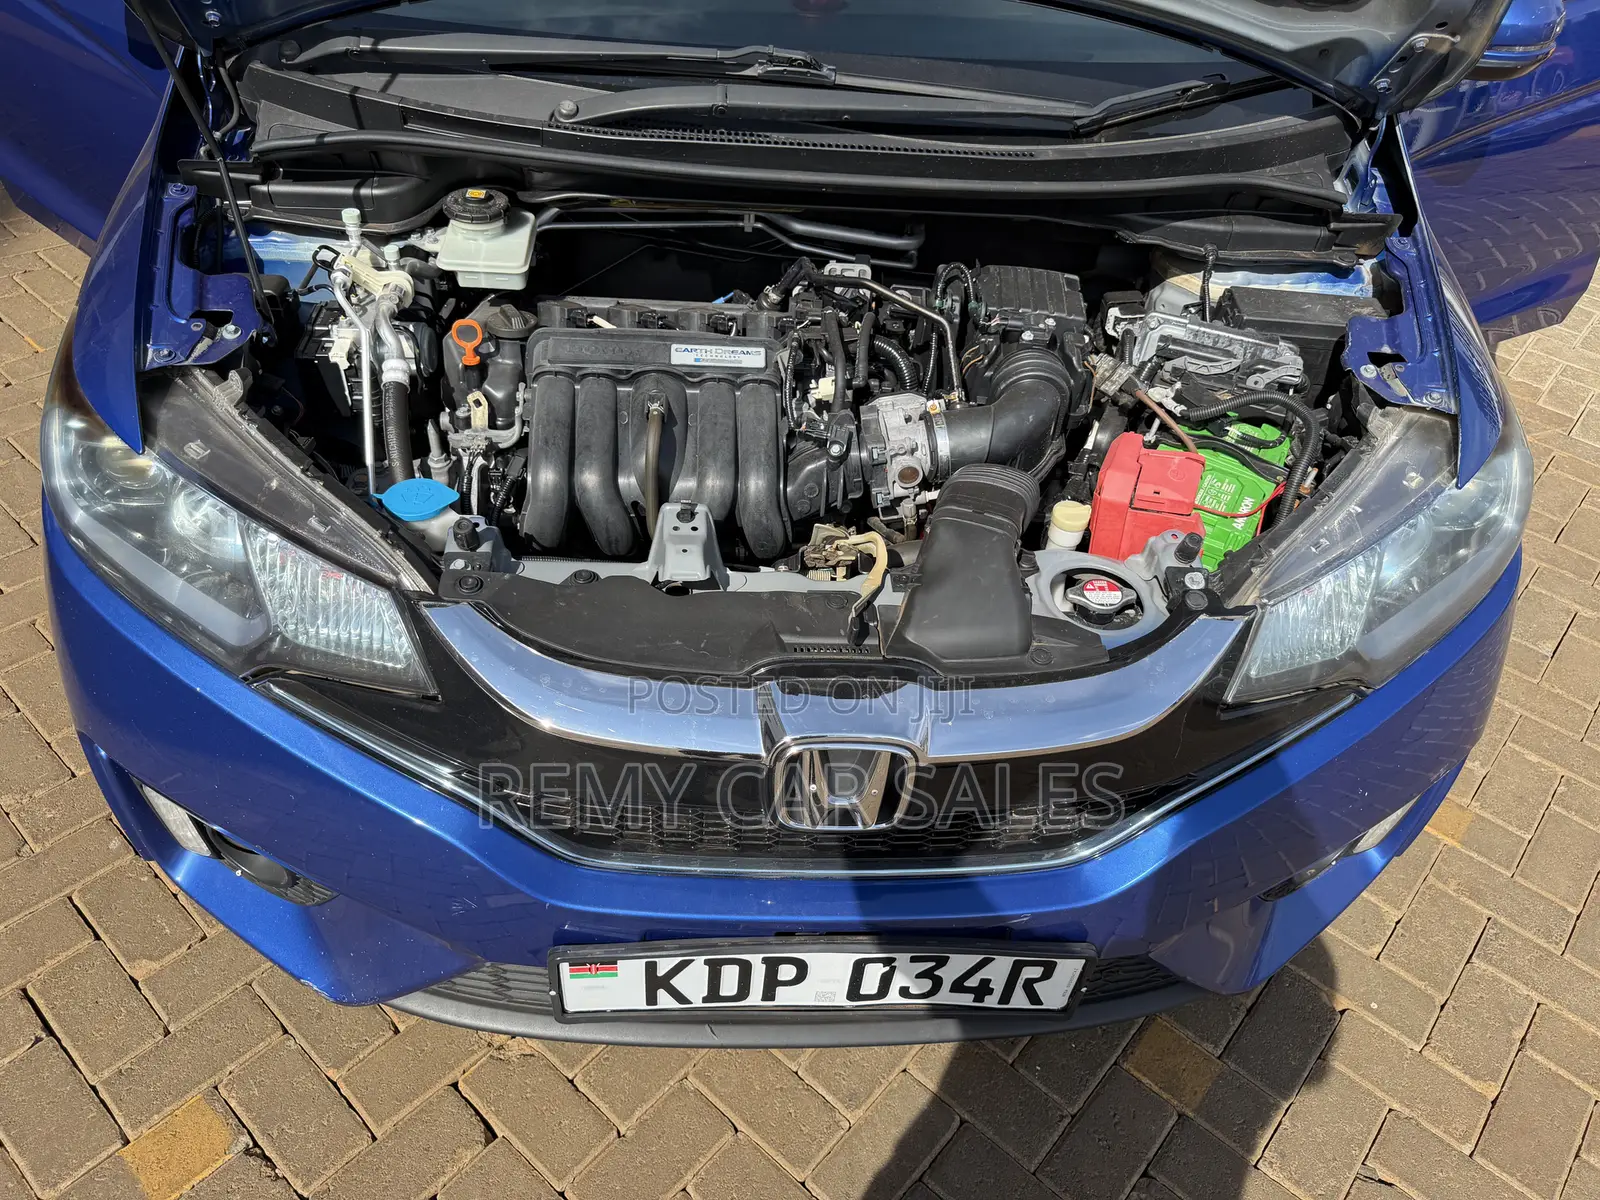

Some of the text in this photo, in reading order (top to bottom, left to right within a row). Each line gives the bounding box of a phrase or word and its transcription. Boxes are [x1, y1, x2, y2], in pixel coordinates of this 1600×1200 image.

[715, 348, 762, 356] DREAMS
[1232, 497, 1254, 530] AMRON
[645, 957, 808, 1006] KDP
[845, 954, 1058, 1006] 034R
